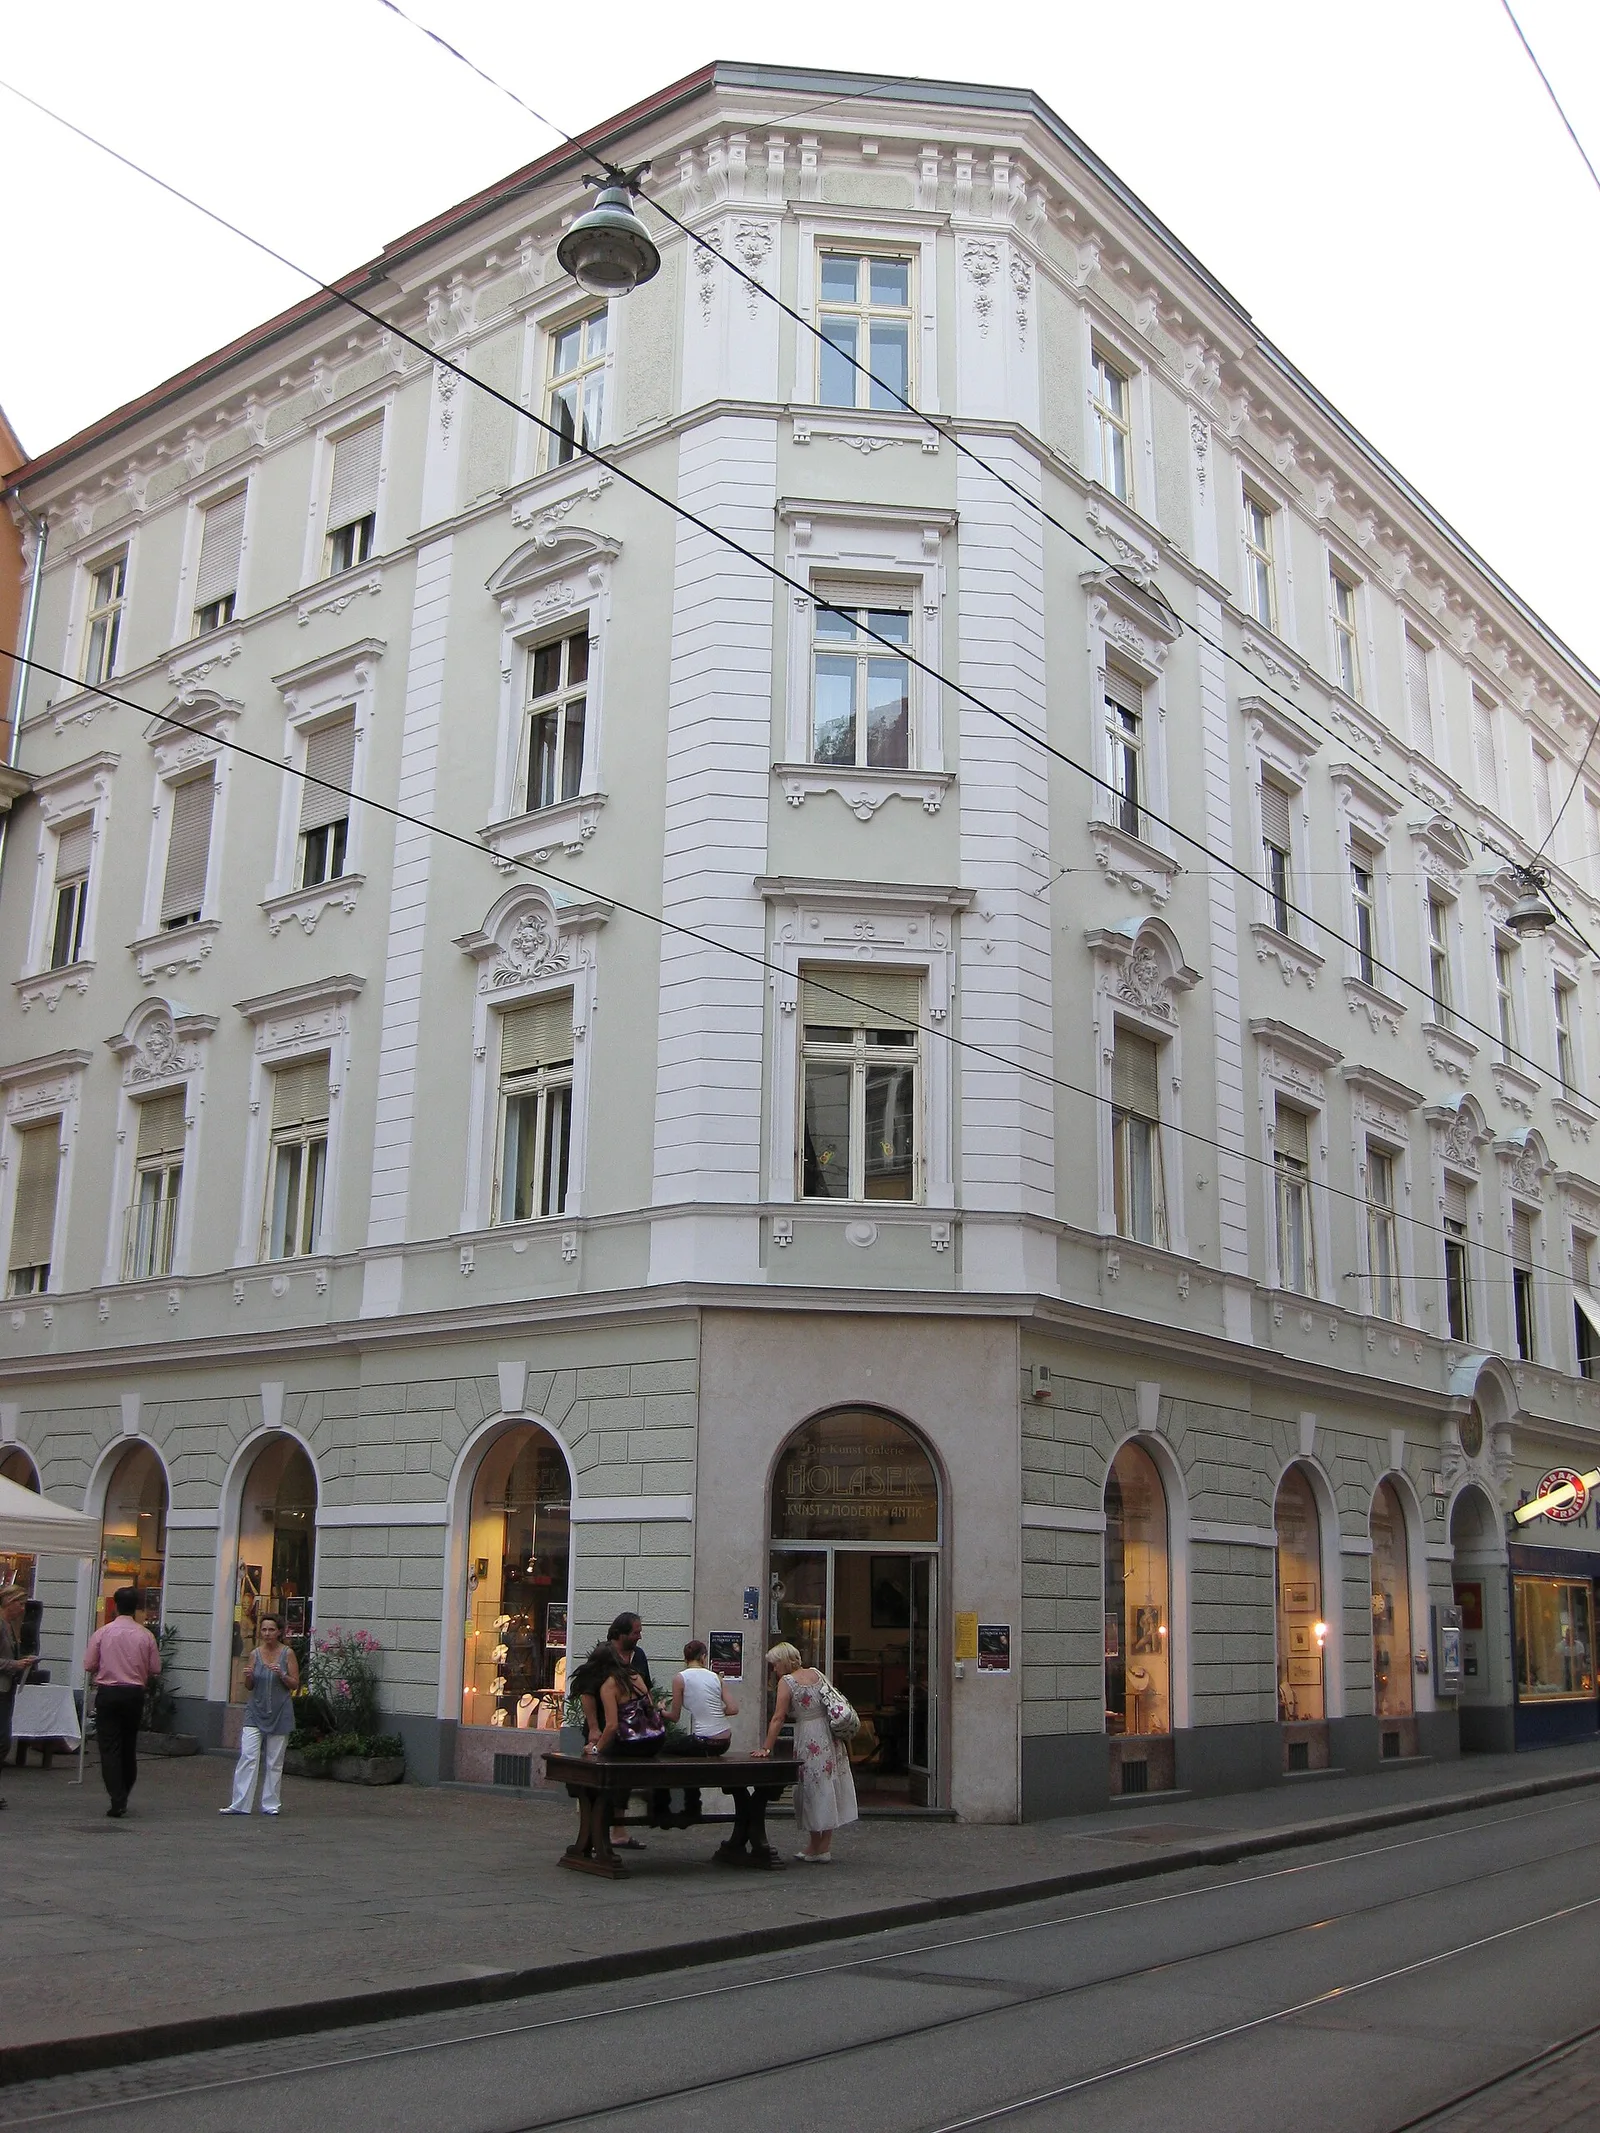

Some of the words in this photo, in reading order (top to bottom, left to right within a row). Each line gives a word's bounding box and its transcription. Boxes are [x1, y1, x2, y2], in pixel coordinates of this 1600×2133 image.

[807, 1443, 825, 1455] Die
[830, 1443, 862, 1455] Kunst
[865, 1444, 905, 1456] Galerie
[786, 1464, 923, 1497] HOLASEK
[1540, 1471, 1575, 1496] TABAK
[831, 1504, 881, 1518] MODERN
[1551, 1489, 1585, 1518] TRAFIK
